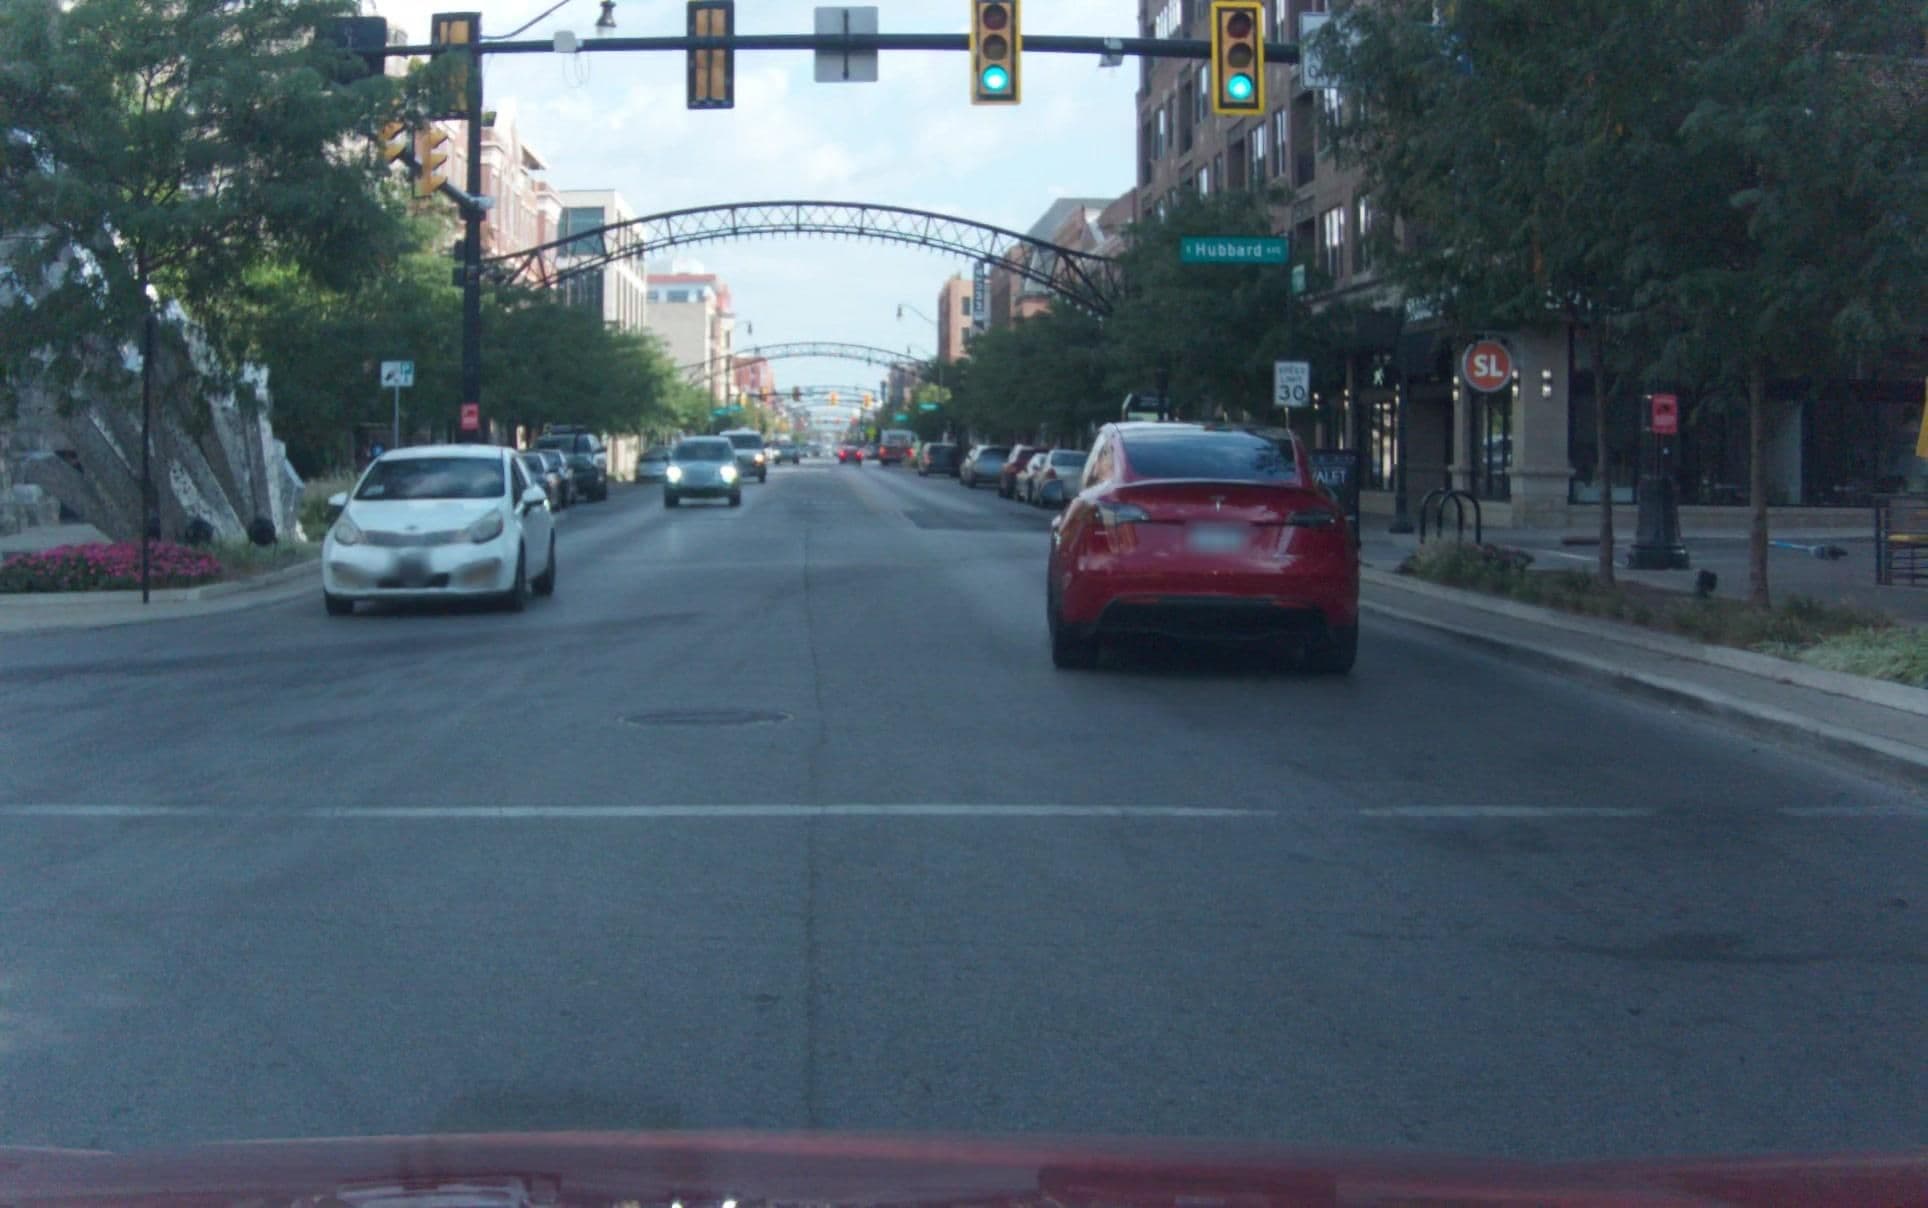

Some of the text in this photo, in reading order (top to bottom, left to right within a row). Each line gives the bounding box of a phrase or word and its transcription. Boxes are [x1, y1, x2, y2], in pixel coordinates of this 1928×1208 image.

[1195, 242, 1262, 257] Hubbard
[1473, 354, 1504, 377] SL
[1279, 384, 1305, 401] 30
